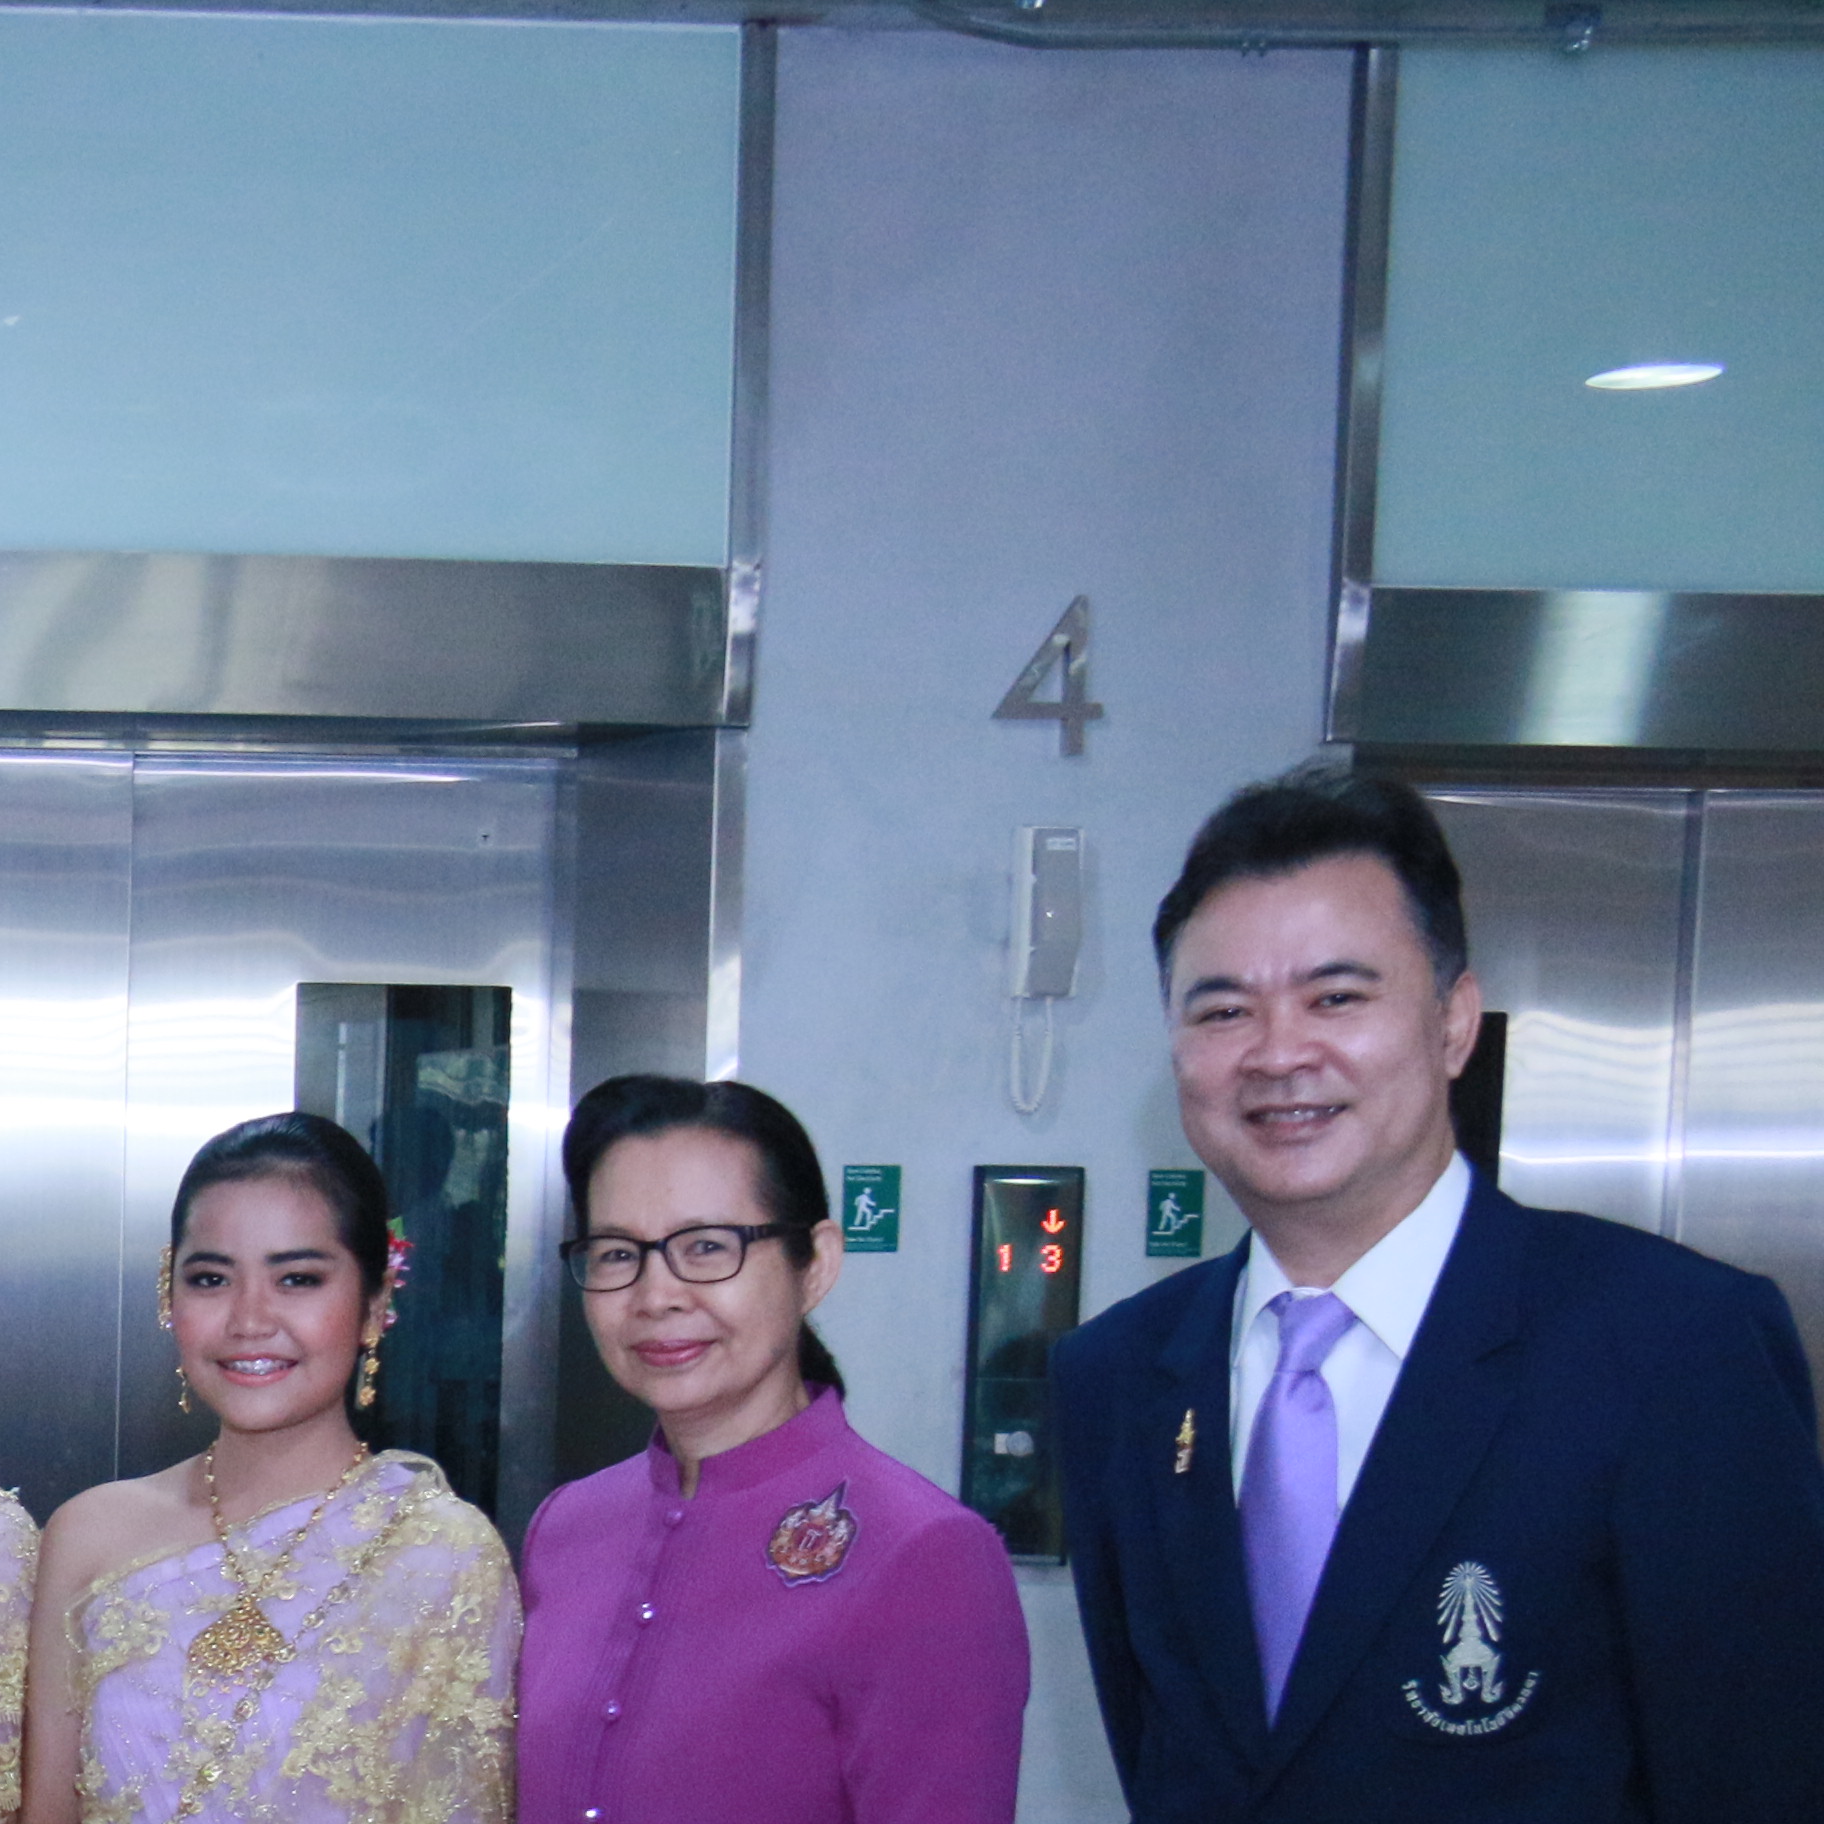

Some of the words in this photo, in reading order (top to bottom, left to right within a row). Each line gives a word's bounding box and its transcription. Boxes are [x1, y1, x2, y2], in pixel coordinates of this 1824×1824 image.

[992, 594, 1104, 757] 4
[997, 1243, 1012, 1273] 1
[1040, 1243, 1063, 1273] 3
